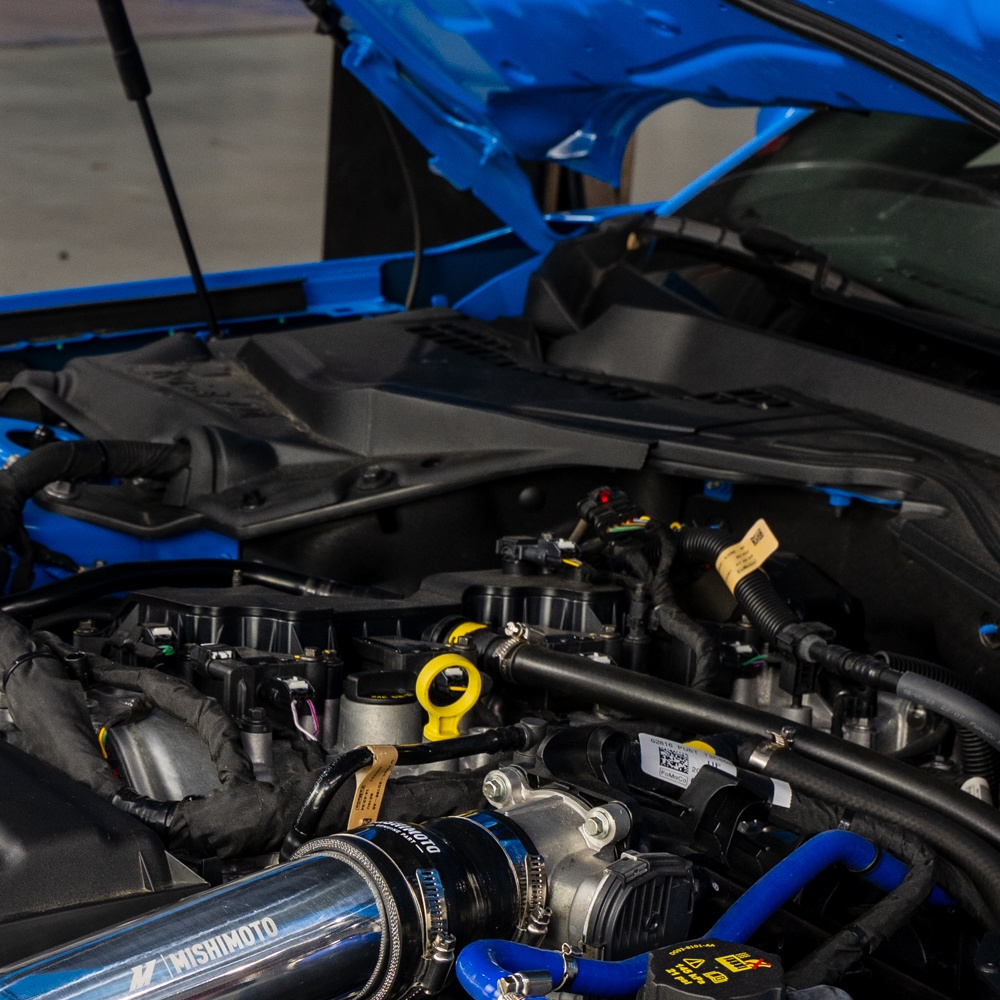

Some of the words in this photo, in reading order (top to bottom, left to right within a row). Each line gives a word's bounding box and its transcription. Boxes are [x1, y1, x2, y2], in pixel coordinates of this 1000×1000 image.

[660, 770, 688, 784] FoMoCo
[400, 833, 417, 844] PART
[169, 916, 279, 974] MISHIMOTO
[665, 968, 681, 977] 21
[675, 963, 694, 974] 145
